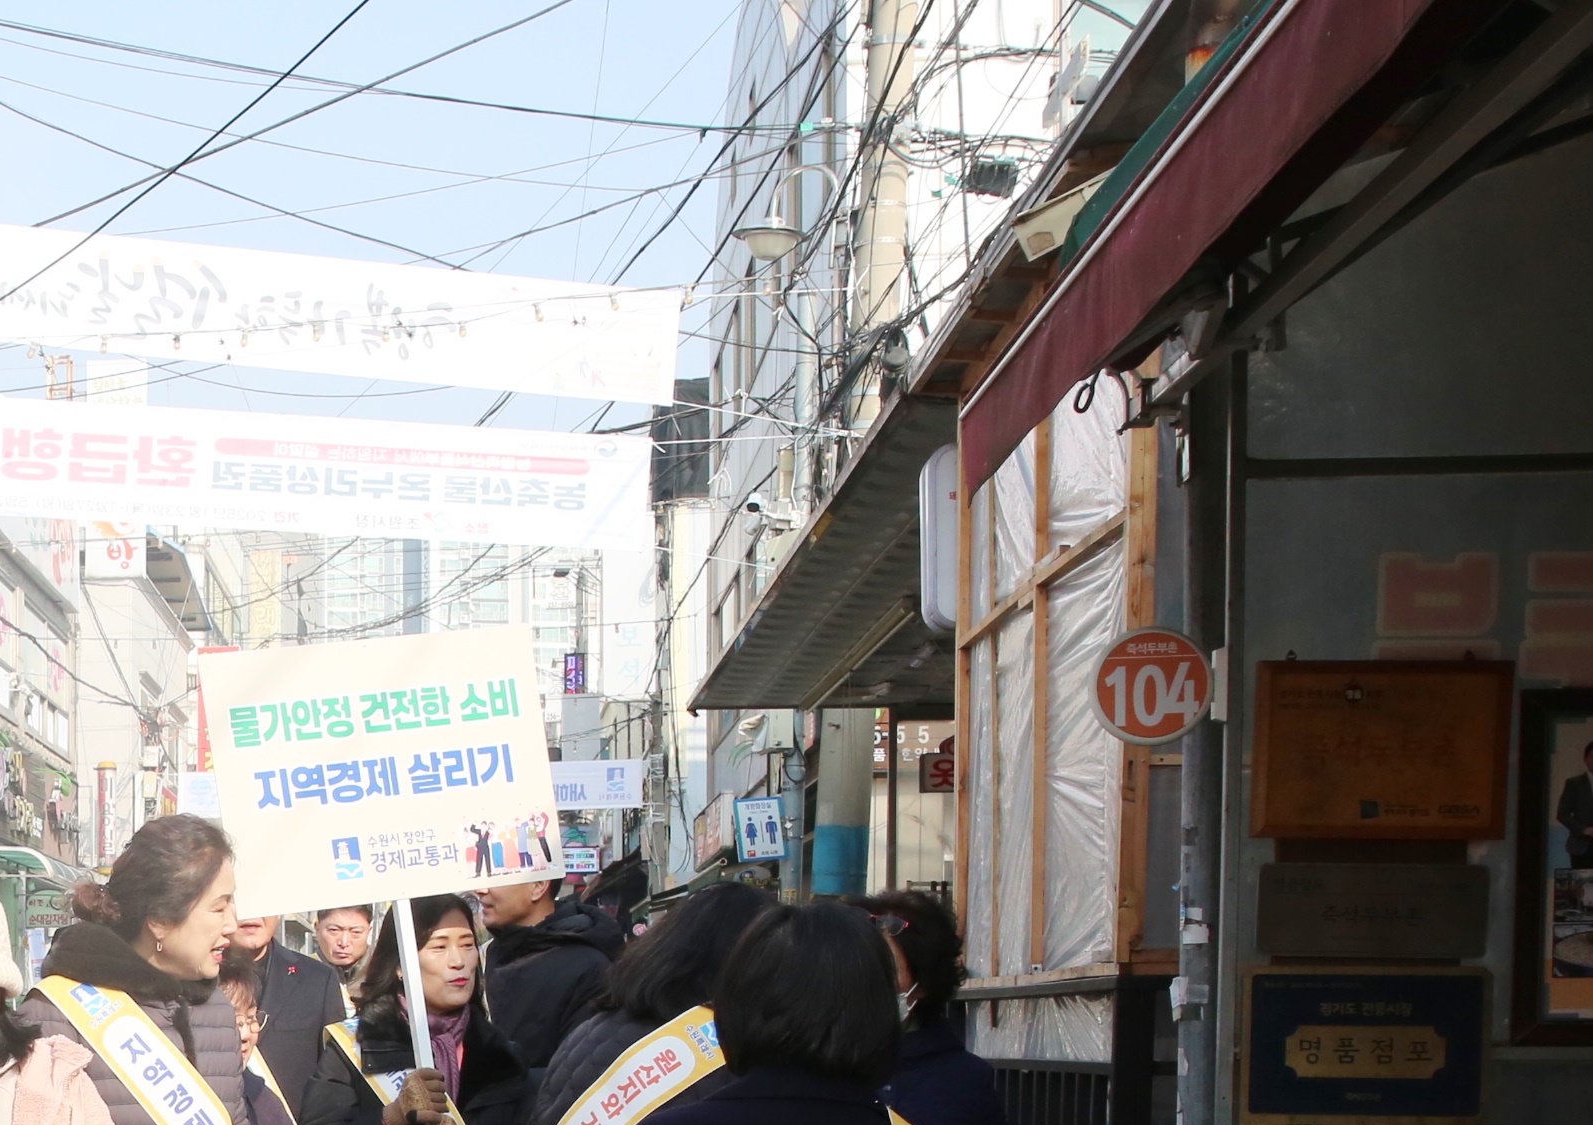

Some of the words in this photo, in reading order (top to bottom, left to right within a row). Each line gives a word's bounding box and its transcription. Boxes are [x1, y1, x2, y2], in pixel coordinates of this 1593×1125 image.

[617, 626, 643, 685] 보석
[1125, 641, 1178, 655] 즉석두부촌
[229, 695, 354, 748] 물가안정
[359, 685, 450, 733] 건전한
[461, 678, 519, 721] 소비
[1105, 661, 1201, 727] 104
[254, 756, 400, 809] 지역경제
[408, 744, 514, 794] 살리기
[102, 777, 114, 854] 미용실
[367, 833, 401, 848] 수원시
[403, 829, 436, 845] 장안구
[370, 843, 459, 873] 경제교통과
[1320, 1002, 1356, 1016] 경기도
[1362, 1002, 1412, 1017] 전통시장
[686, 1024, 715, 1061] 수원특례시
[601, 1048, 682, 1120] 원산지와
